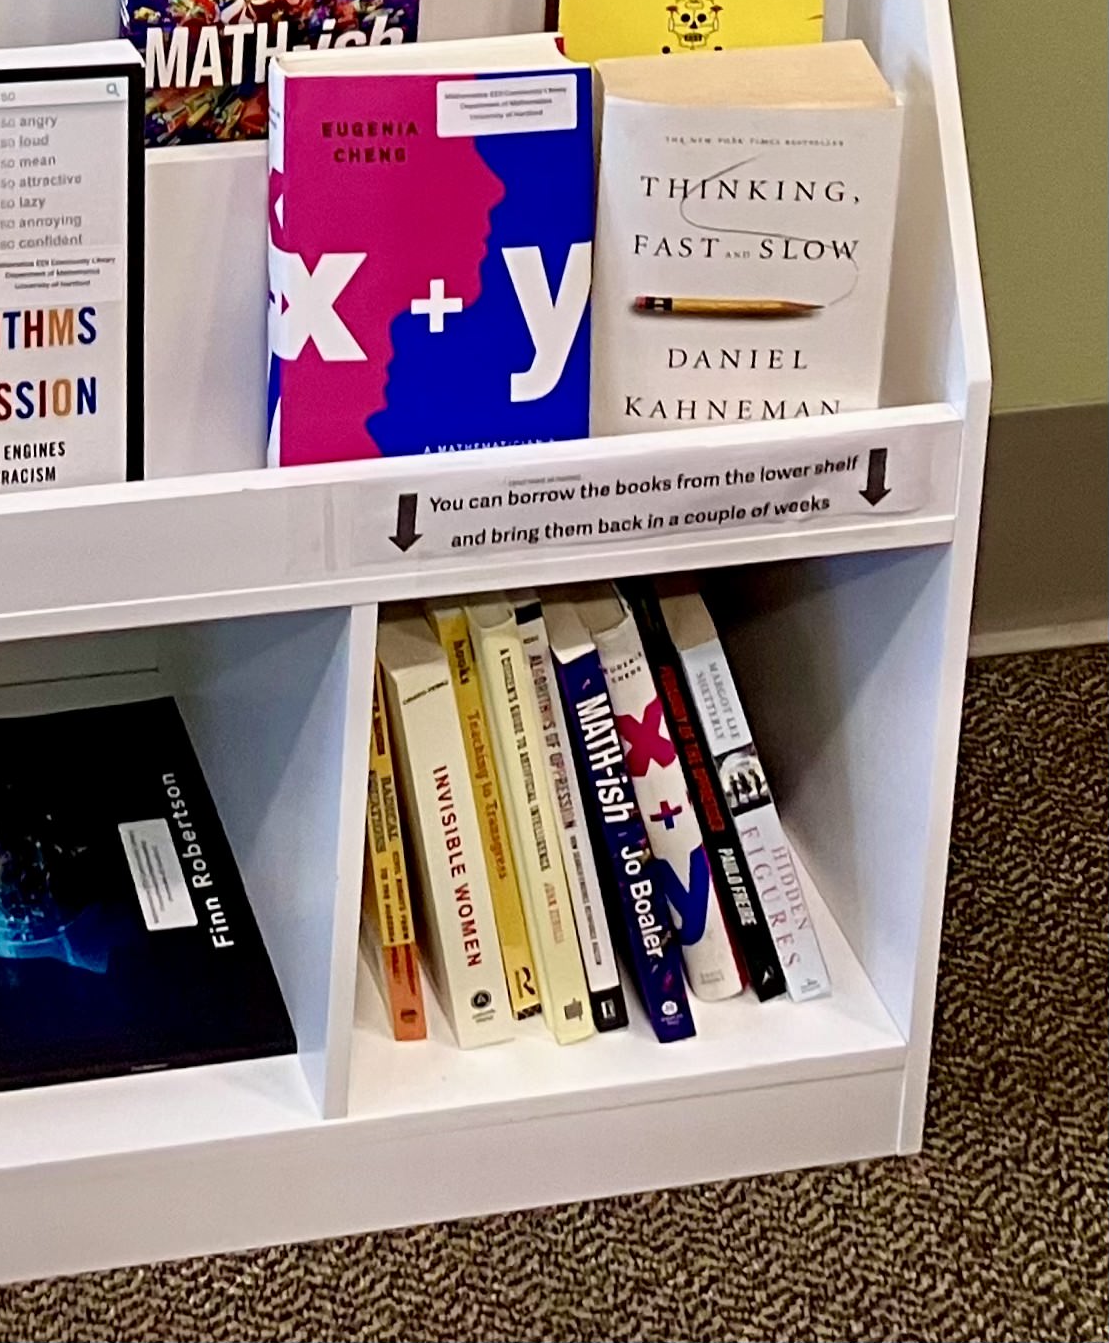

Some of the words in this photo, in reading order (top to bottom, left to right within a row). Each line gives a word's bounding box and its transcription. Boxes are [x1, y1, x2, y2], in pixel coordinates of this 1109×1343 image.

[322, 121, 418, 139] EUGENIA
[334, 148, 407, 163] CHENG
[641, 175, 860, 204] THINKING,
[634, 235, 720, 259] FAST
[759, 238, 859, 260] SLOW
[668, 348, 808, 369] DANIEL
[625, 395, 841, 420] KAHNEMAN
[3, 441, 66, 461] ENGINES
[0, 465, 56, 485] RACISM
[576, 695, 634, 823] MATH-ish
[161, 772, 213, 889] Robertson
[433, 765, 466, 877] INVISIBLE
[621, 847, 641, 875] Jo
[204, 895, 235, 948] Finn
[454, 884, 482, 967] WOMEN
[630, 879, 663, 958] Boaler
